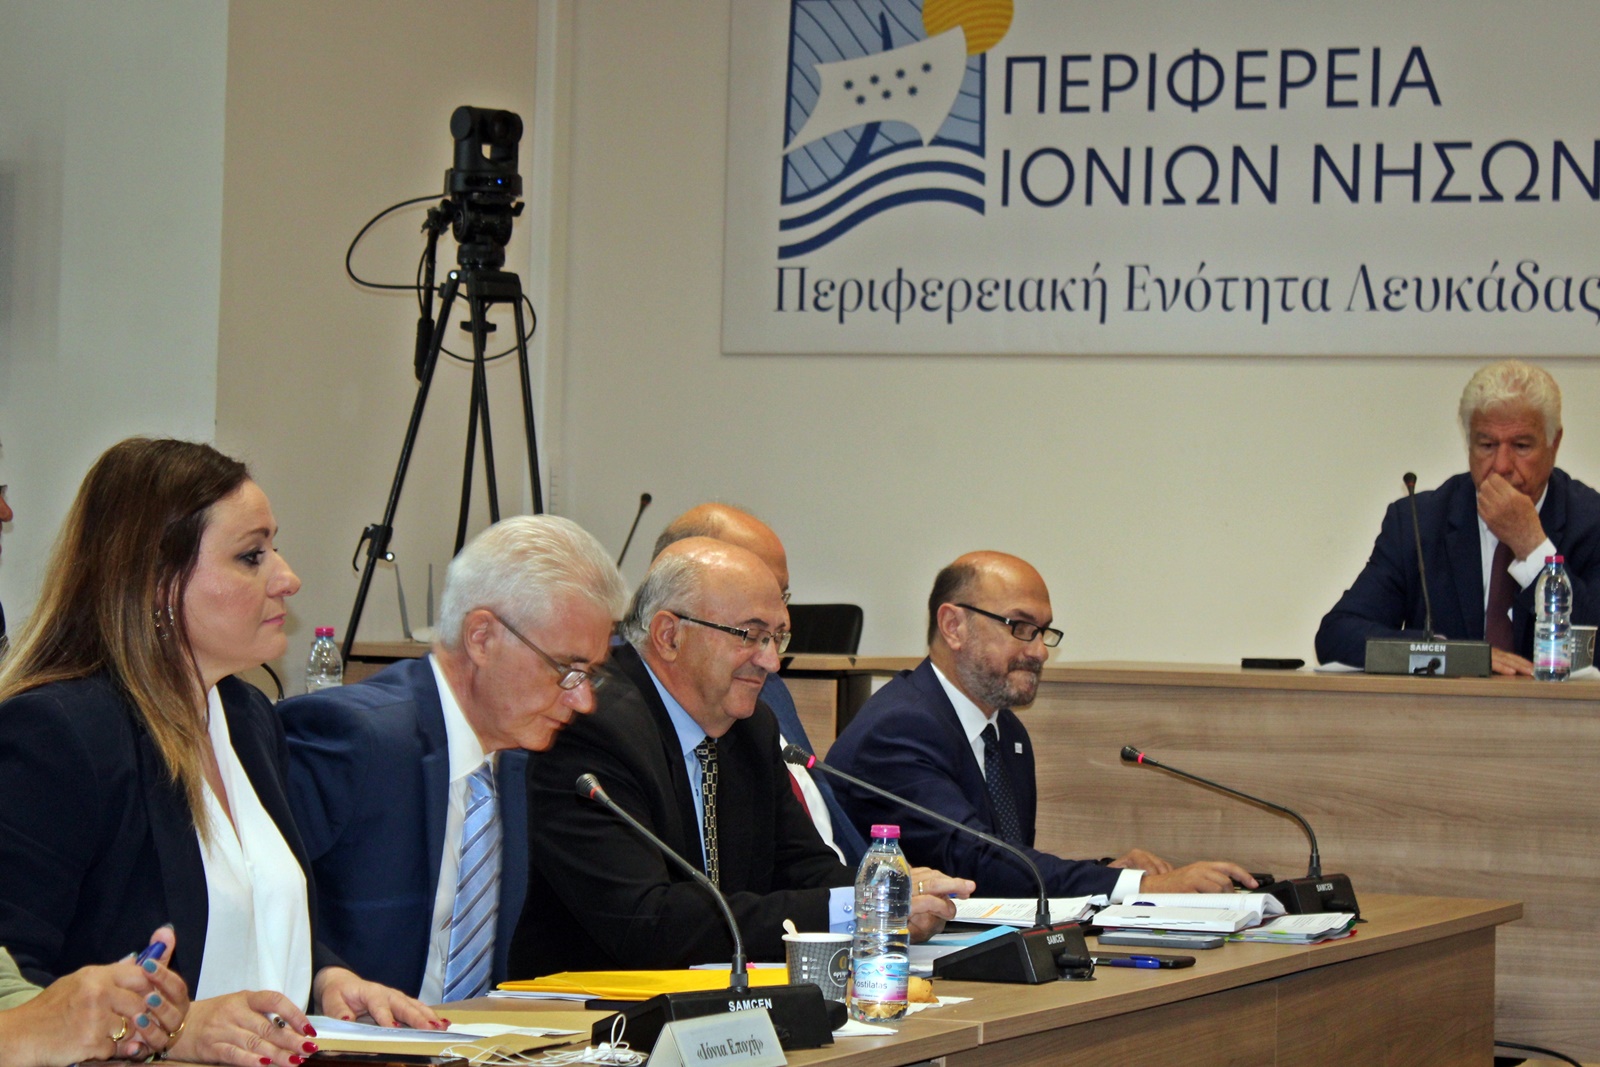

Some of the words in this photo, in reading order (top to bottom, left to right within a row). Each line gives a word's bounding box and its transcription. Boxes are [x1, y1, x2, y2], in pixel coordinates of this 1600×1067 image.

[1003, 46, 1442, 115] ΠΕΡΙΦΕΡΕΙΑ
[1001, 144, 1279, 208] ΙΟΝΙΩΝ
[1312, 139, 1600, 204] ΝΗΣΩΝ
[775, 262, 1108, 325] Περιφερειακή
[1123, 262, 1331, 325] Ενότητα
[1345, 259, 1600, 326] Λευκάδας
[1410, 643, 1446, 652] SAMCEN
[728, 998, 773, 1012] SAMCEN
[696, 1042, 728, 1060] «Ιόνια
[726, 1034, 764, 1057] Εποχή»
